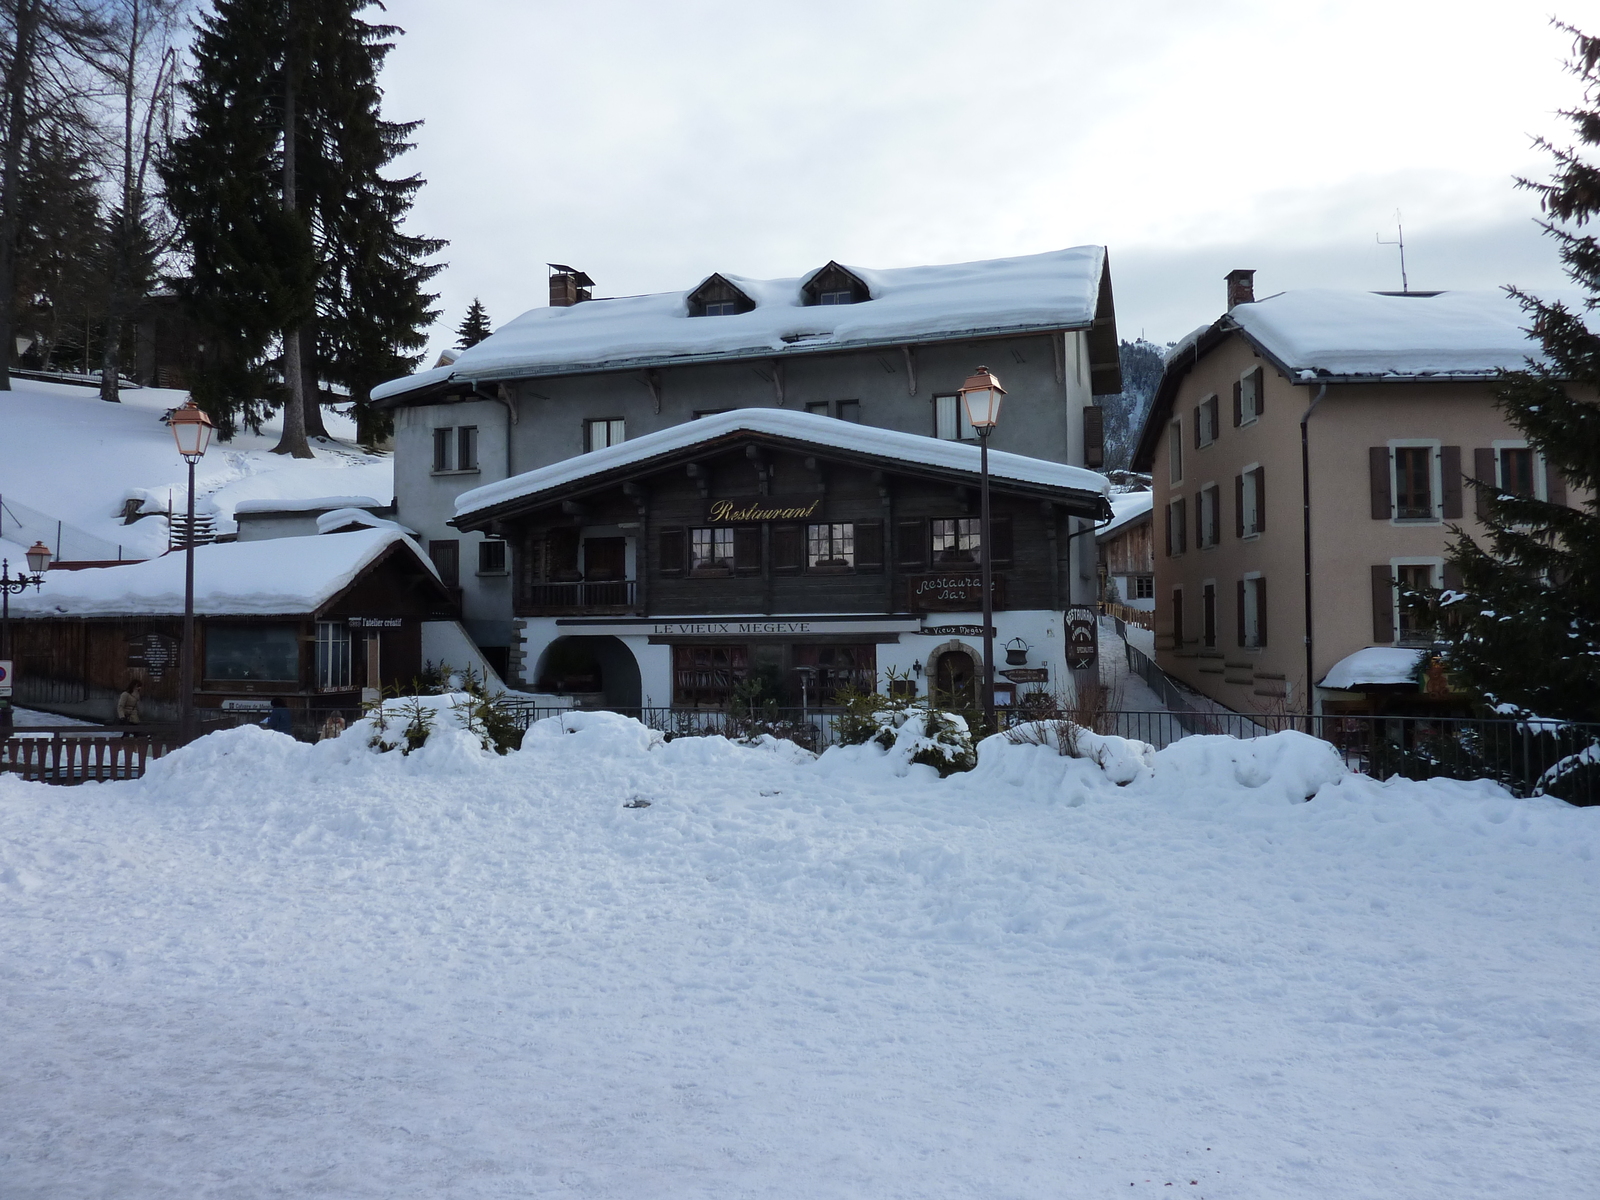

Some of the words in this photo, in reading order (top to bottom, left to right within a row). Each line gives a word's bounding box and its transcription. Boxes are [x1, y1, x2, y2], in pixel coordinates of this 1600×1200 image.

[707, 499, 820, 522] Restaurant
[916, 577, 995, 594] Restaurat
[937, 589, 967, 600] Bar
[654, 624, 674, 634] LE
[679, 623, 729, 634] VIEUX
[738, 622, 811, 633] MEGEVE
[932, 627, 956, 635] Vieux
[959, 626, 984, 636] Megèv
